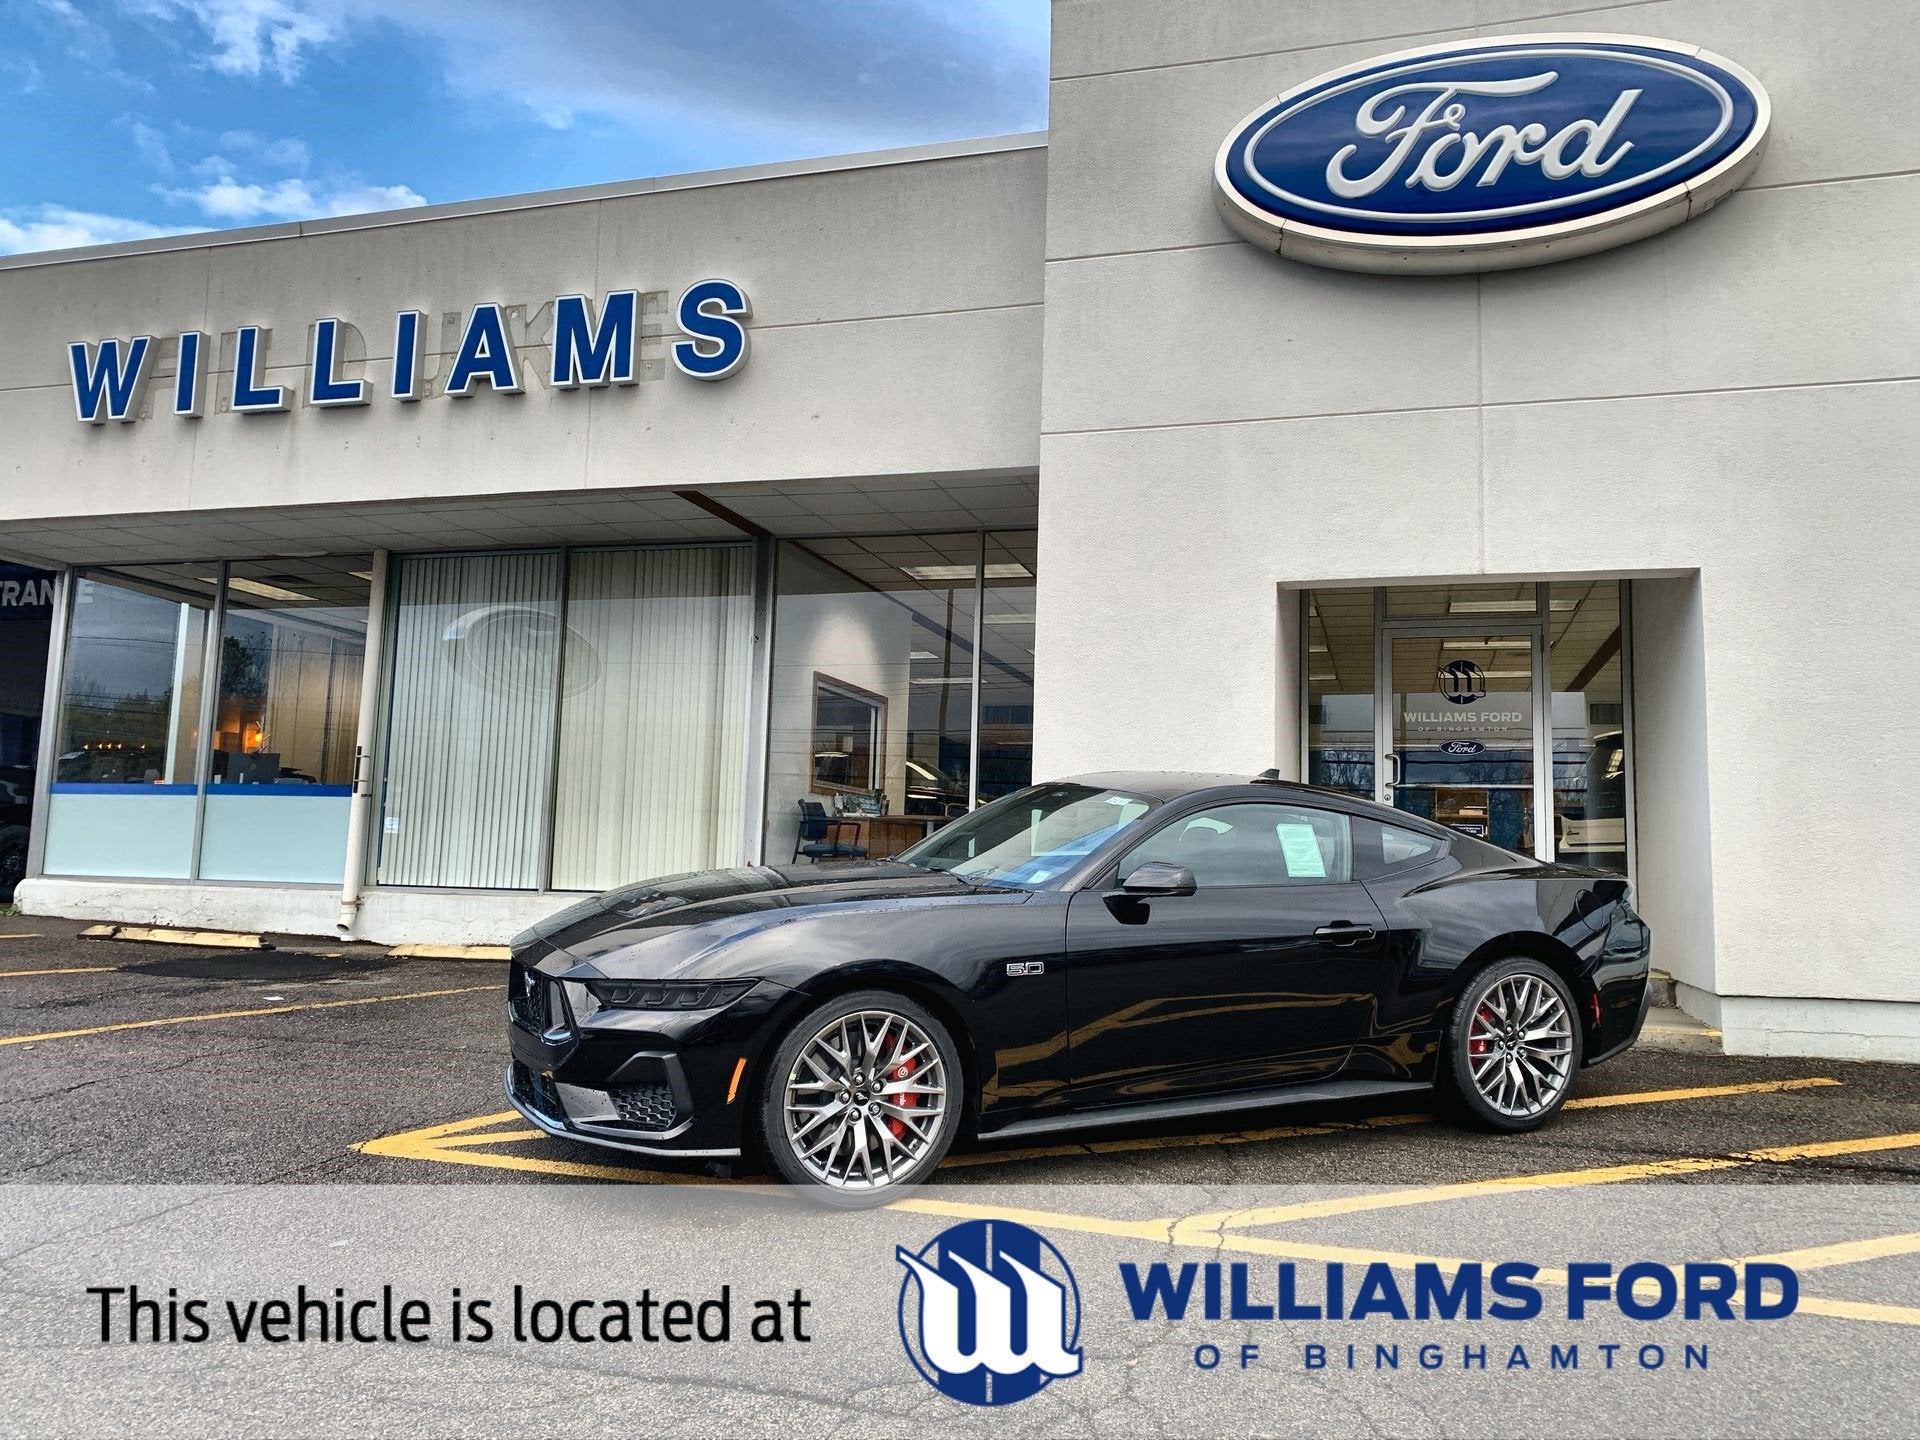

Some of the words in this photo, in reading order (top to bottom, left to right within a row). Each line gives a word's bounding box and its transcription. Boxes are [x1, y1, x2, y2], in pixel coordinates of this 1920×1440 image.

[1325, 70, 1644, 199] Ford
[67, 279, 752, 425] WILLIAMS
[1403, 711, 1477, 723] WILLIAMS
[1480, 711, 1523, 723] FORD
[1447, 740, 1477, 753] Ford
[1006, 961, 1045, 977] 5.0
